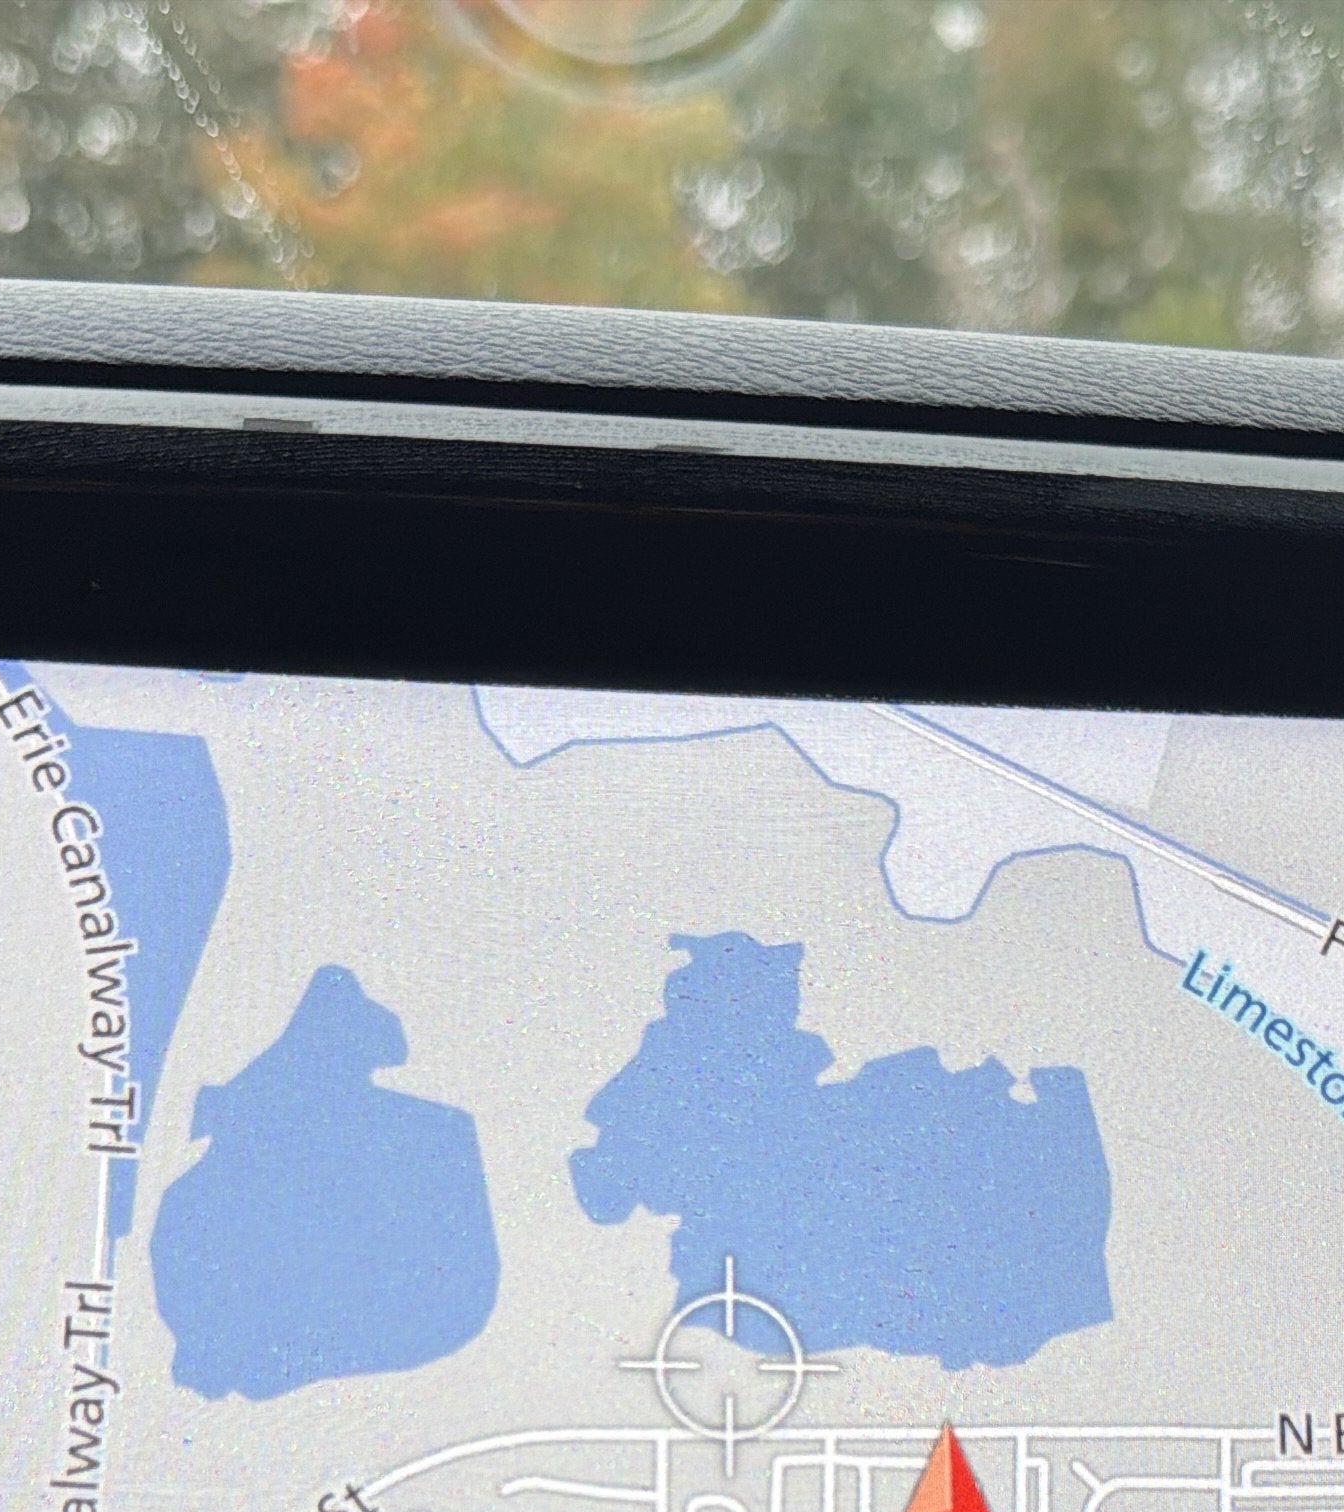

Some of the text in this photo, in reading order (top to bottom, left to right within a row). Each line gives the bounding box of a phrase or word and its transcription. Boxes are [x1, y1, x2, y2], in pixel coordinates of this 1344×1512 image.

[51, 804, 136, 1072] Canalway
[88, 1084, 137, 1156] Trl
[64, 1280, 115, 1348] Trl
[1277, 1413, 1314, 1456] N
